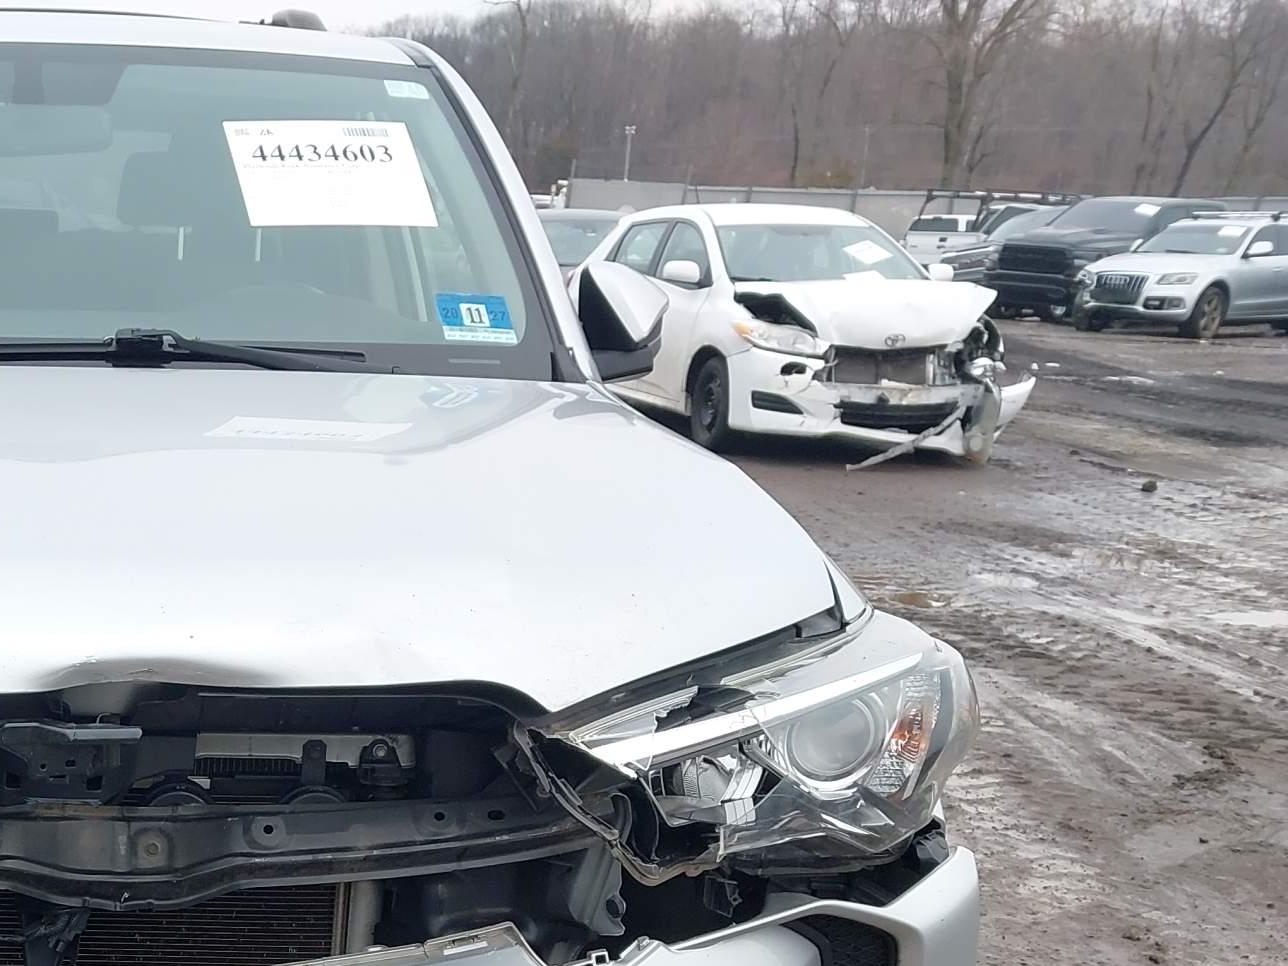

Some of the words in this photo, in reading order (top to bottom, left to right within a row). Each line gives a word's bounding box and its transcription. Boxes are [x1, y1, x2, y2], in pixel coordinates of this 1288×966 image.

[251, 143, 393, 163] 44434603
[441, 307, 458, 319] 20
[465, 306, 486, 324] 11
